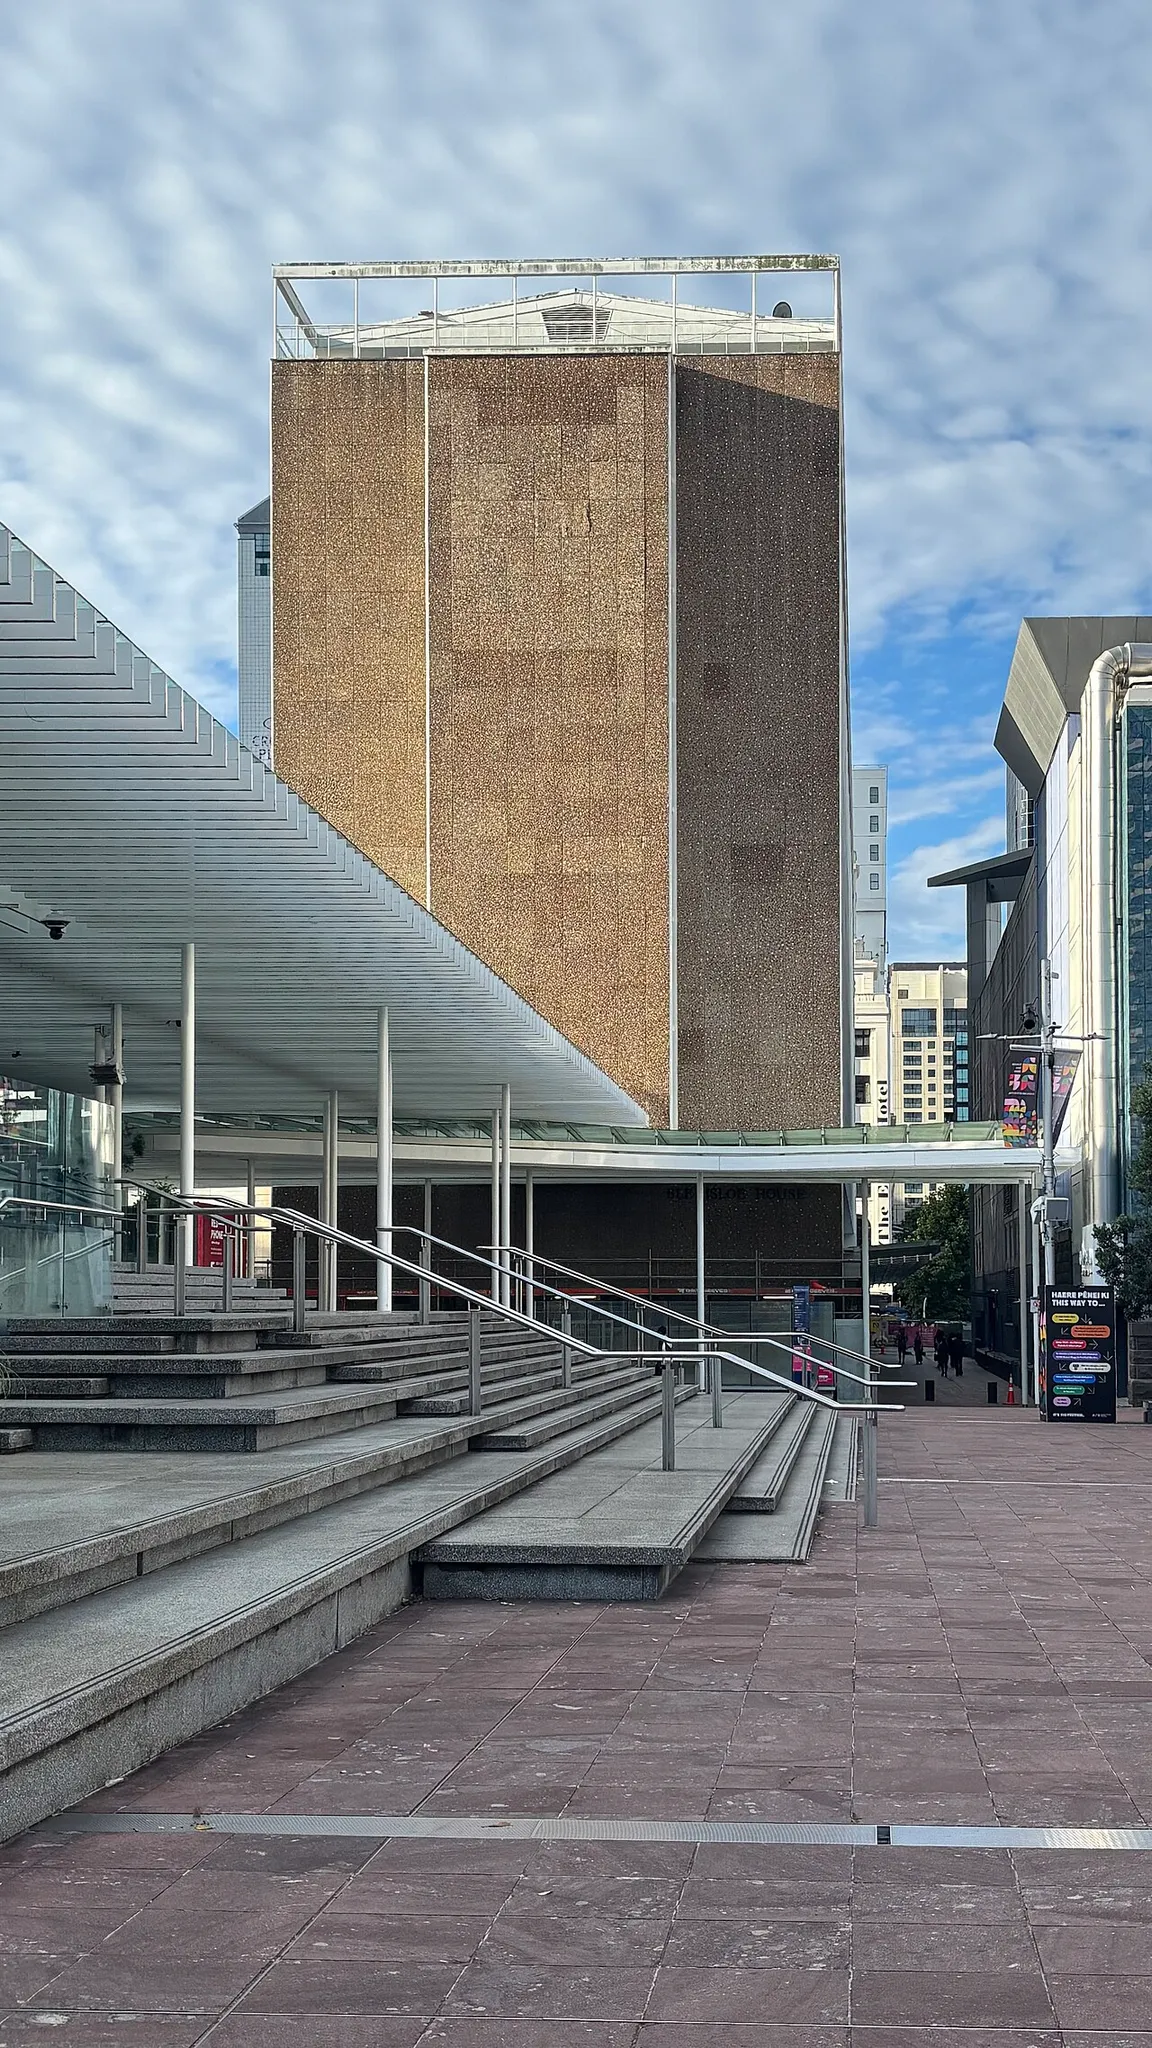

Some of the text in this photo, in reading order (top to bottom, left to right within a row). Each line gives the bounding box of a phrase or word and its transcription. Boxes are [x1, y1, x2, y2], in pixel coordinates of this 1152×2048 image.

[755, 1187, 808, 1200] HOUSE
[878, 1205, 889, 1243] The
[1051, 1291, 1077, 1299] HAERE
[1101, 1291, 1110, 1299] KI
[1051, 1299, 1069, 1307] THIS
[1070, 1299, 1086, 1307] WAY
